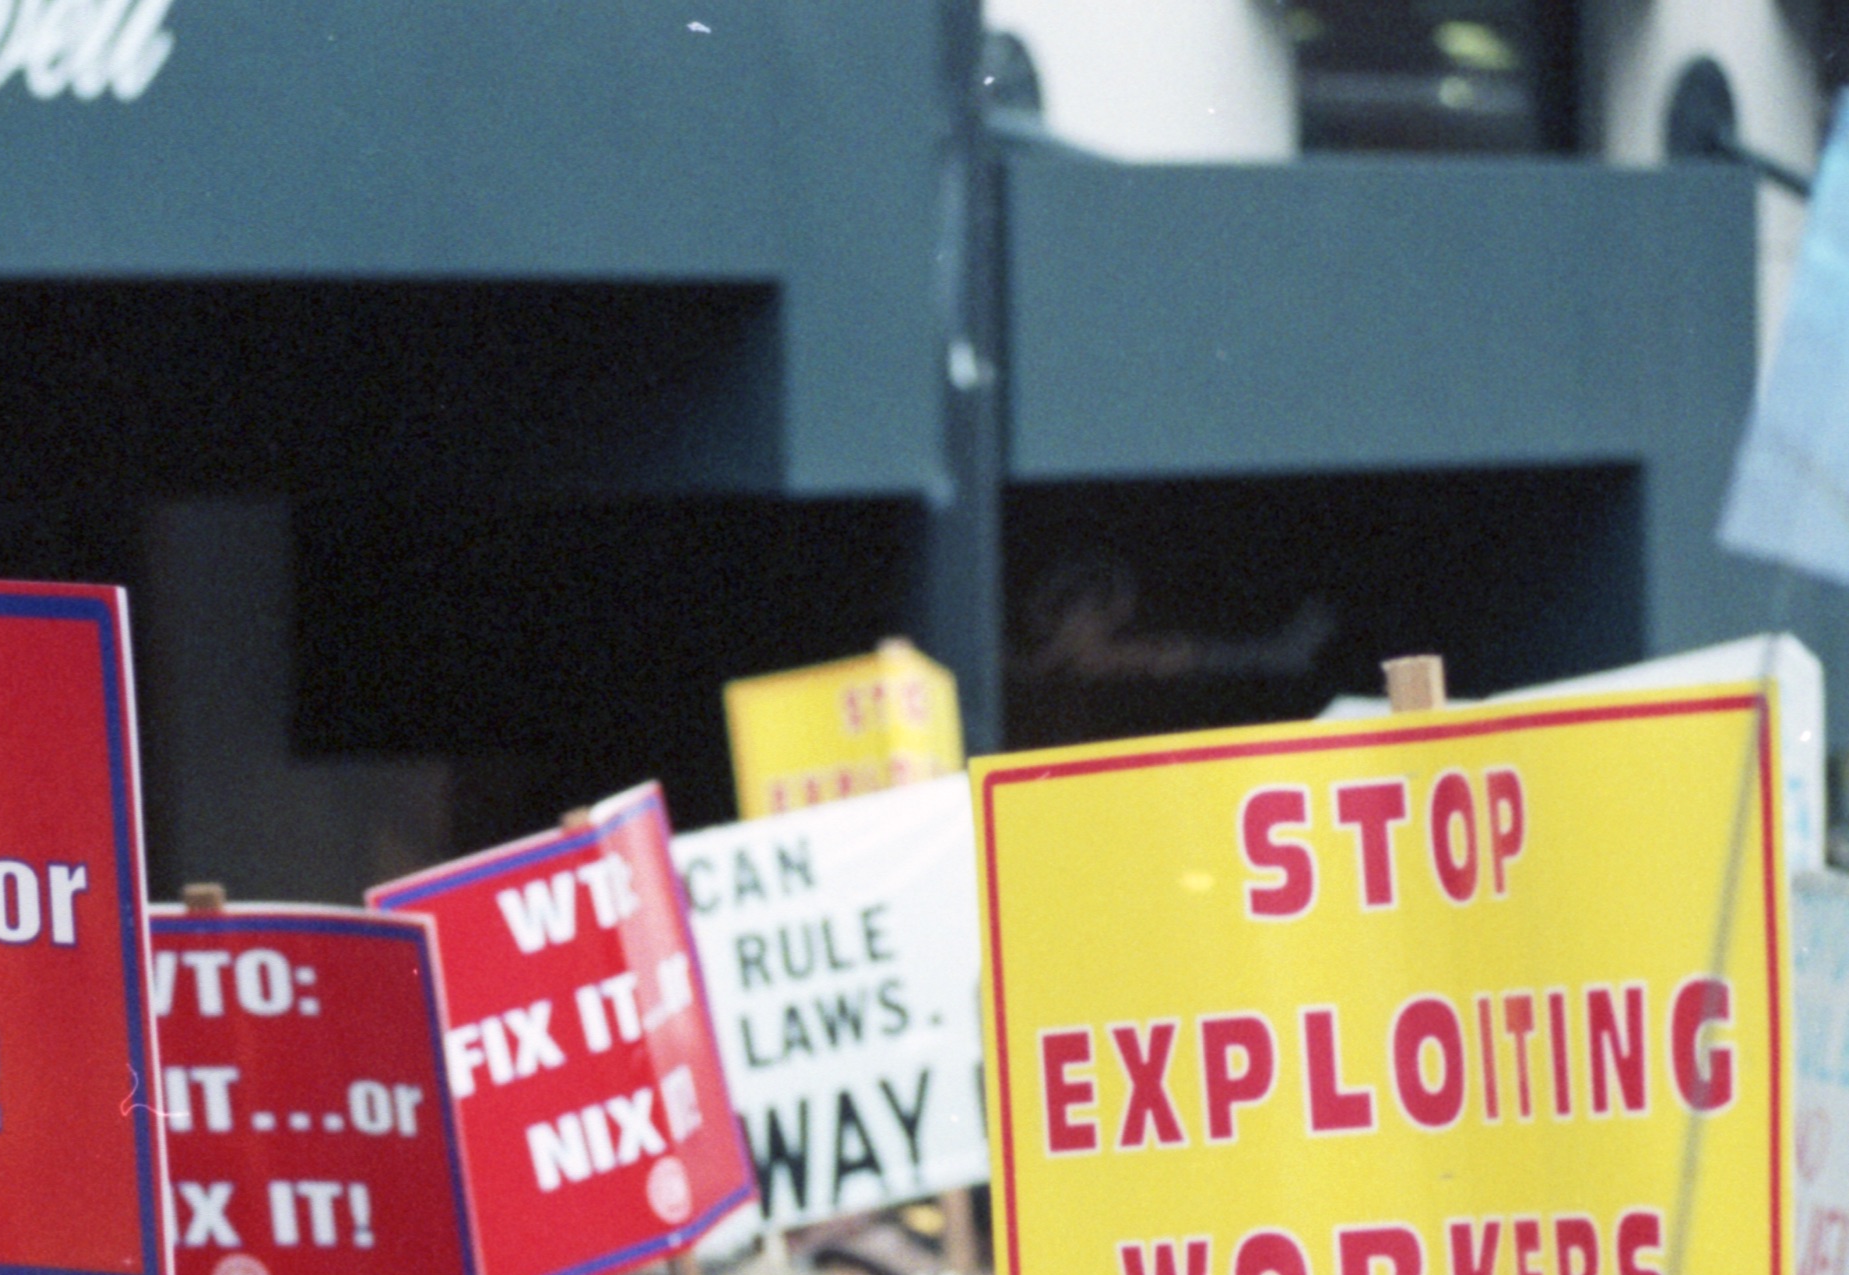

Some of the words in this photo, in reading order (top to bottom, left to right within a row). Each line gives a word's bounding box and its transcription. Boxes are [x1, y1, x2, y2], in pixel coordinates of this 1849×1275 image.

[685, 834, 816, 914] CAN
[1241, 770, 1526, 918] STOP
[735, 905, 897, 991] RULE
[449, 1000, 566, 1101] FIX
[740, 978, 945, 1068] LAWS.
[1040, 978, 1734, 1154] EXPLOITING
[524, 1085, 667, 1193] NIX
[739, 1066, 929, 1220] WAY
[268, 1180, 375, 1248] IT!
